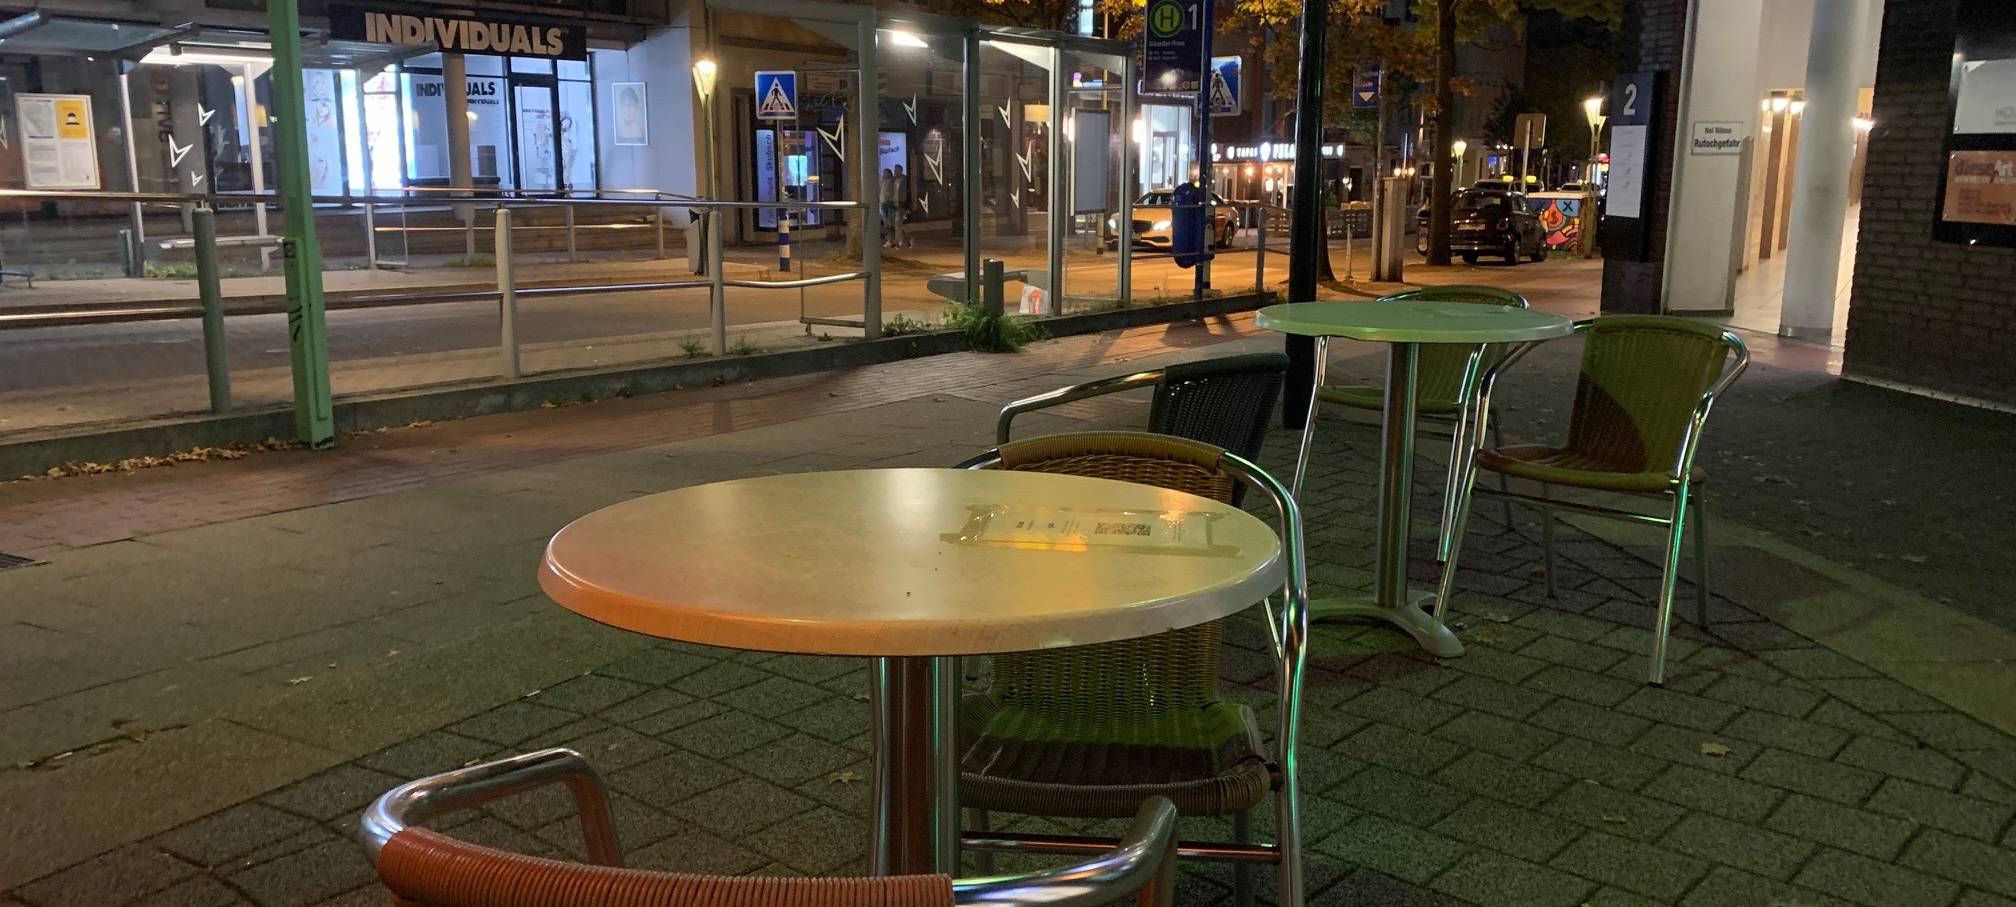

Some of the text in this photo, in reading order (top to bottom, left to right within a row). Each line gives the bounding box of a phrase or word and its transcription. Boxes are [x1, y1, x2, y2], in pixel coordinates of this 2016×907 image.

[1188, 4, 1197, 30] 1
[365, 12, 564, 56] INDIVIDUALS
[1624, 83, 1638, 115] 2
[1694, 138, 1741, 150] Rutschgefahr
